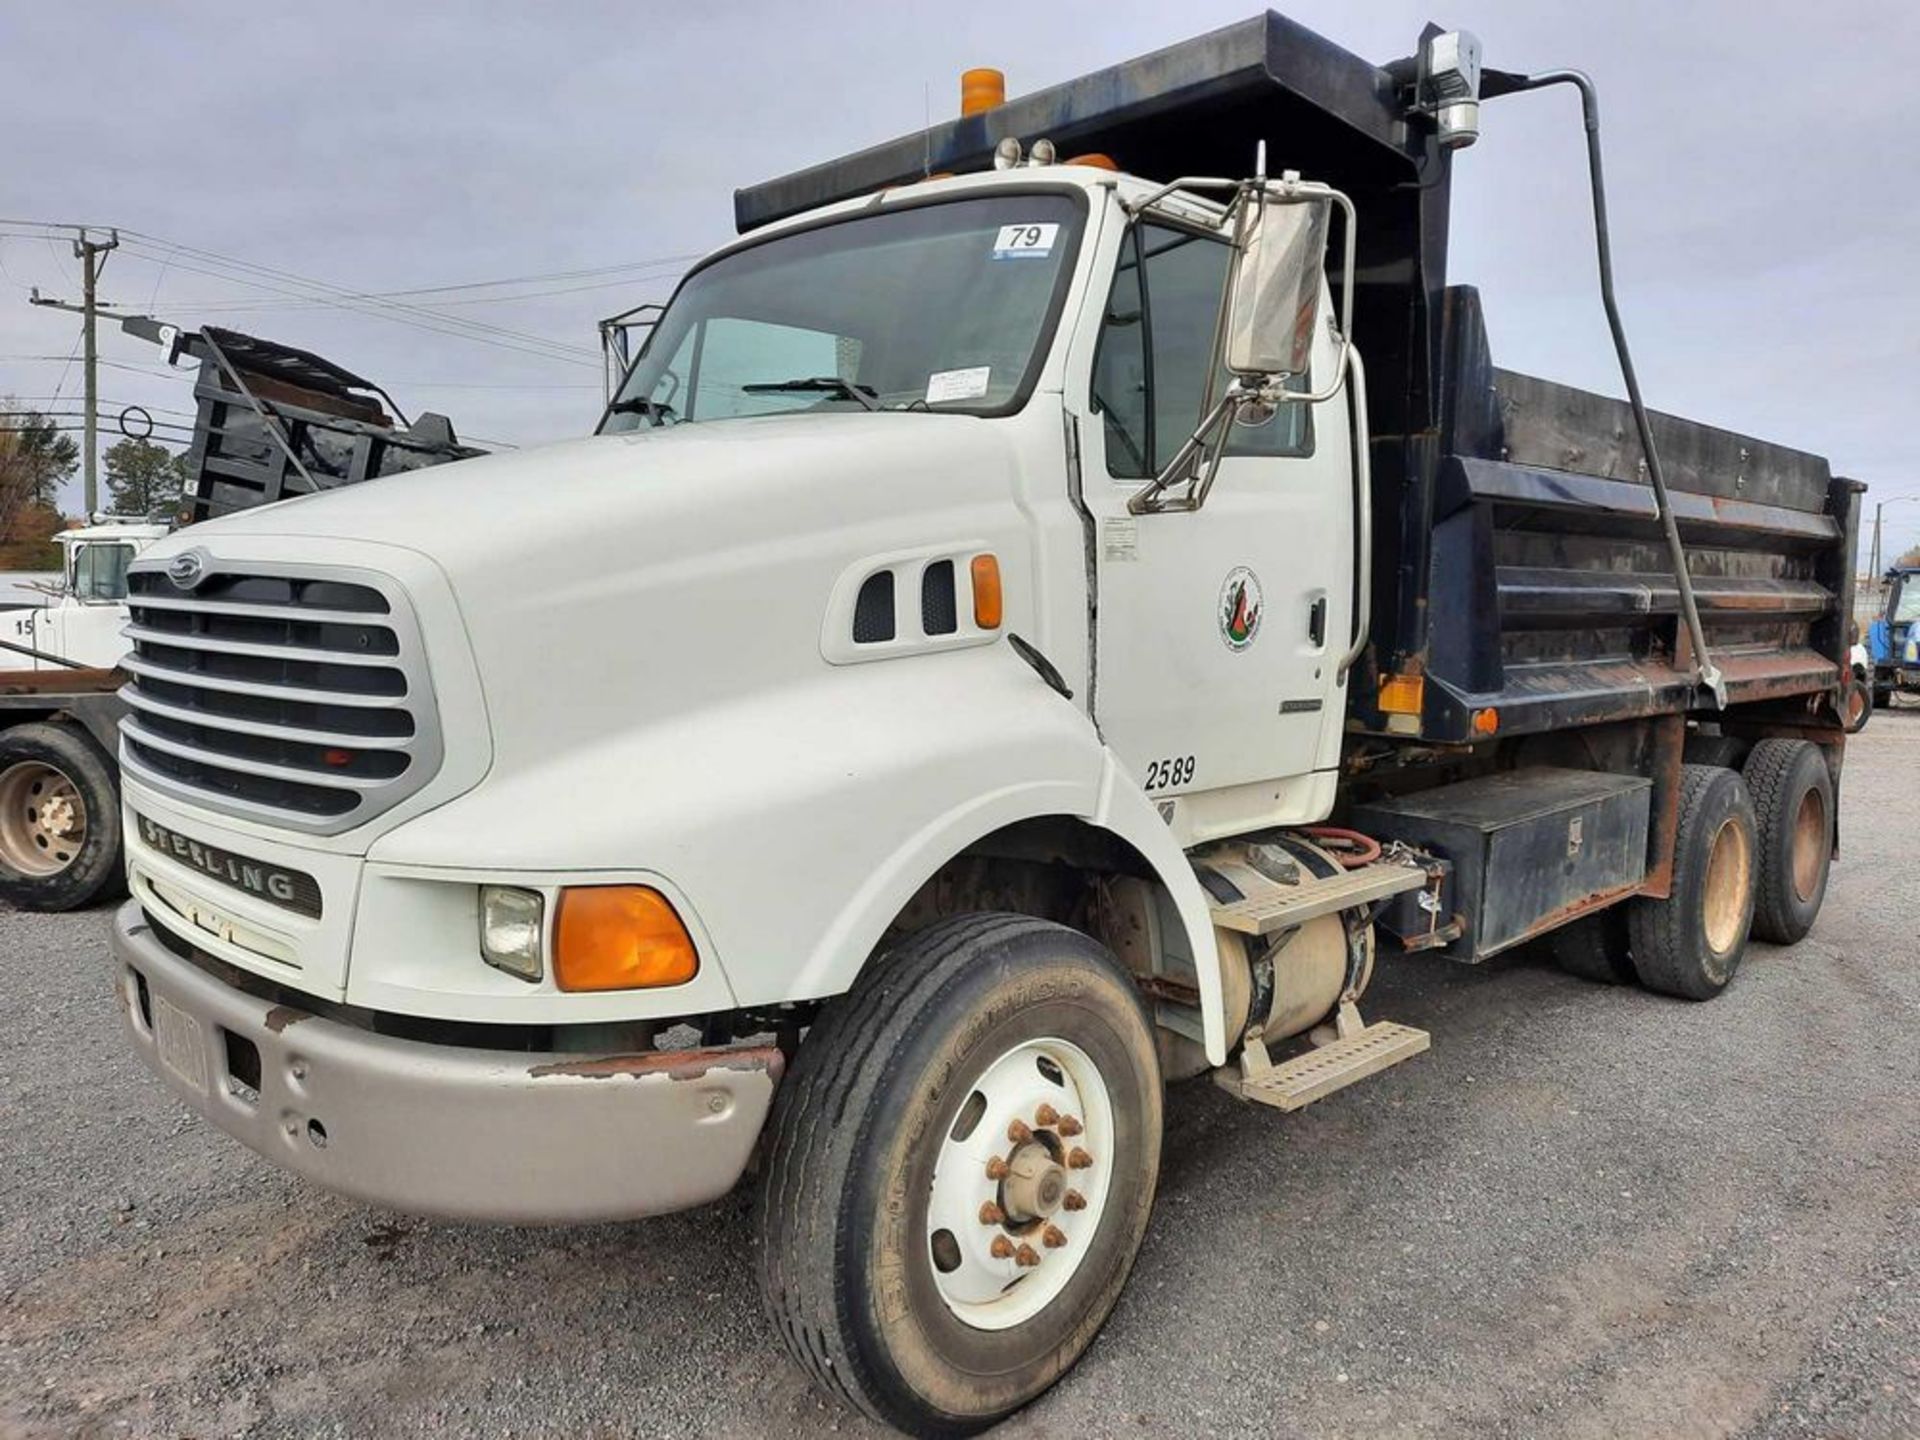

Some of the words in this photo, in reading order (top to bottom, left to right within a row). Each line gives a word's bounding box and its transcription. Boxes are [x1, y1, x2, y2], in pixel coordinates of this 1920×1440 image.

[1010, 226, 1042, 247] 79
[15, 620, 33, 635] 15
[1144, 755, 1195, 791] 2589
[144, 818, 295, 900] STERLING
